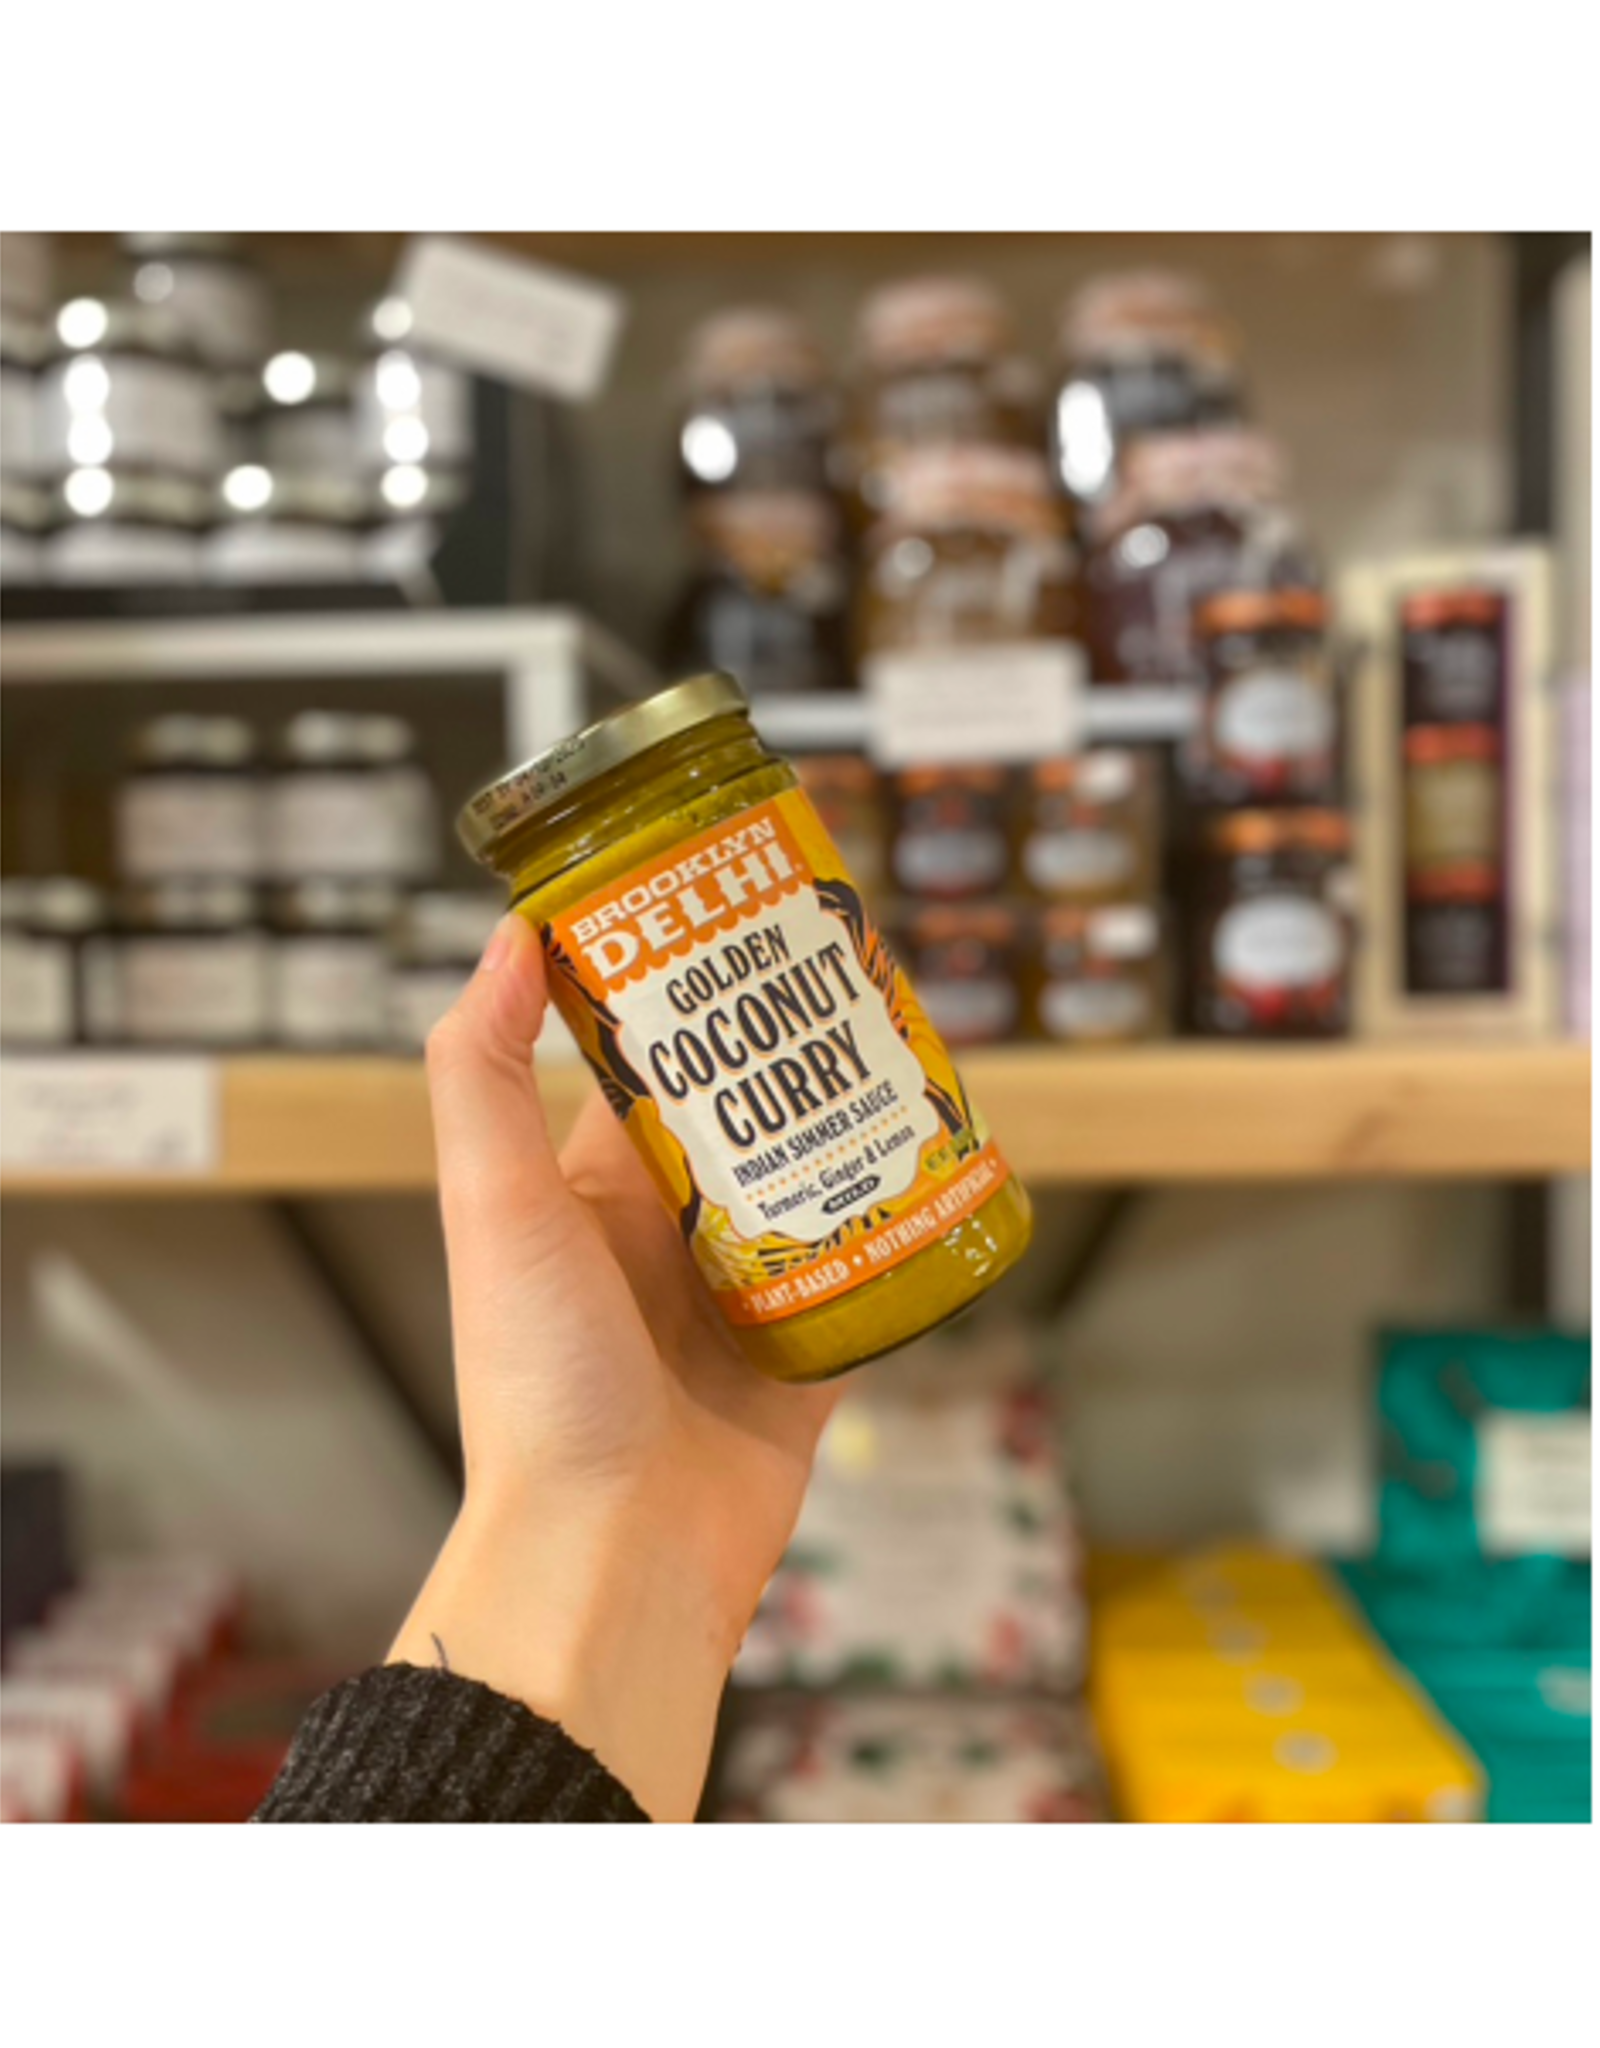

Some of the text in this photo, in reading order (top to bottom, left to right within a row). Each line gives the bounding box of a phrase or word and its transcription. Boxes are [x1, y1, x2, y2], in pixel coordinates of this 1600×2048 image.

[570, 817, 776, 944] BROOKLYN
[581, 841, 794, 980] DELHI
[649, 941, 860, 1100] COCONUT
[666, 923, 791, 1015] GOLDEN
[715, 1020, 871, 1147] CURRY
[732, 1079, 898, 1188] INDIAN SIMMER SAUCE
[818, 1157, 864, 1189] Ginger
[863, 1144, 877, 1164] &
[873, 1125, 915, 1157] Lemon
[750, 1258, 851, 1314] PLANT-BASED
[863, 1206, 938, 1266] NOTHING
